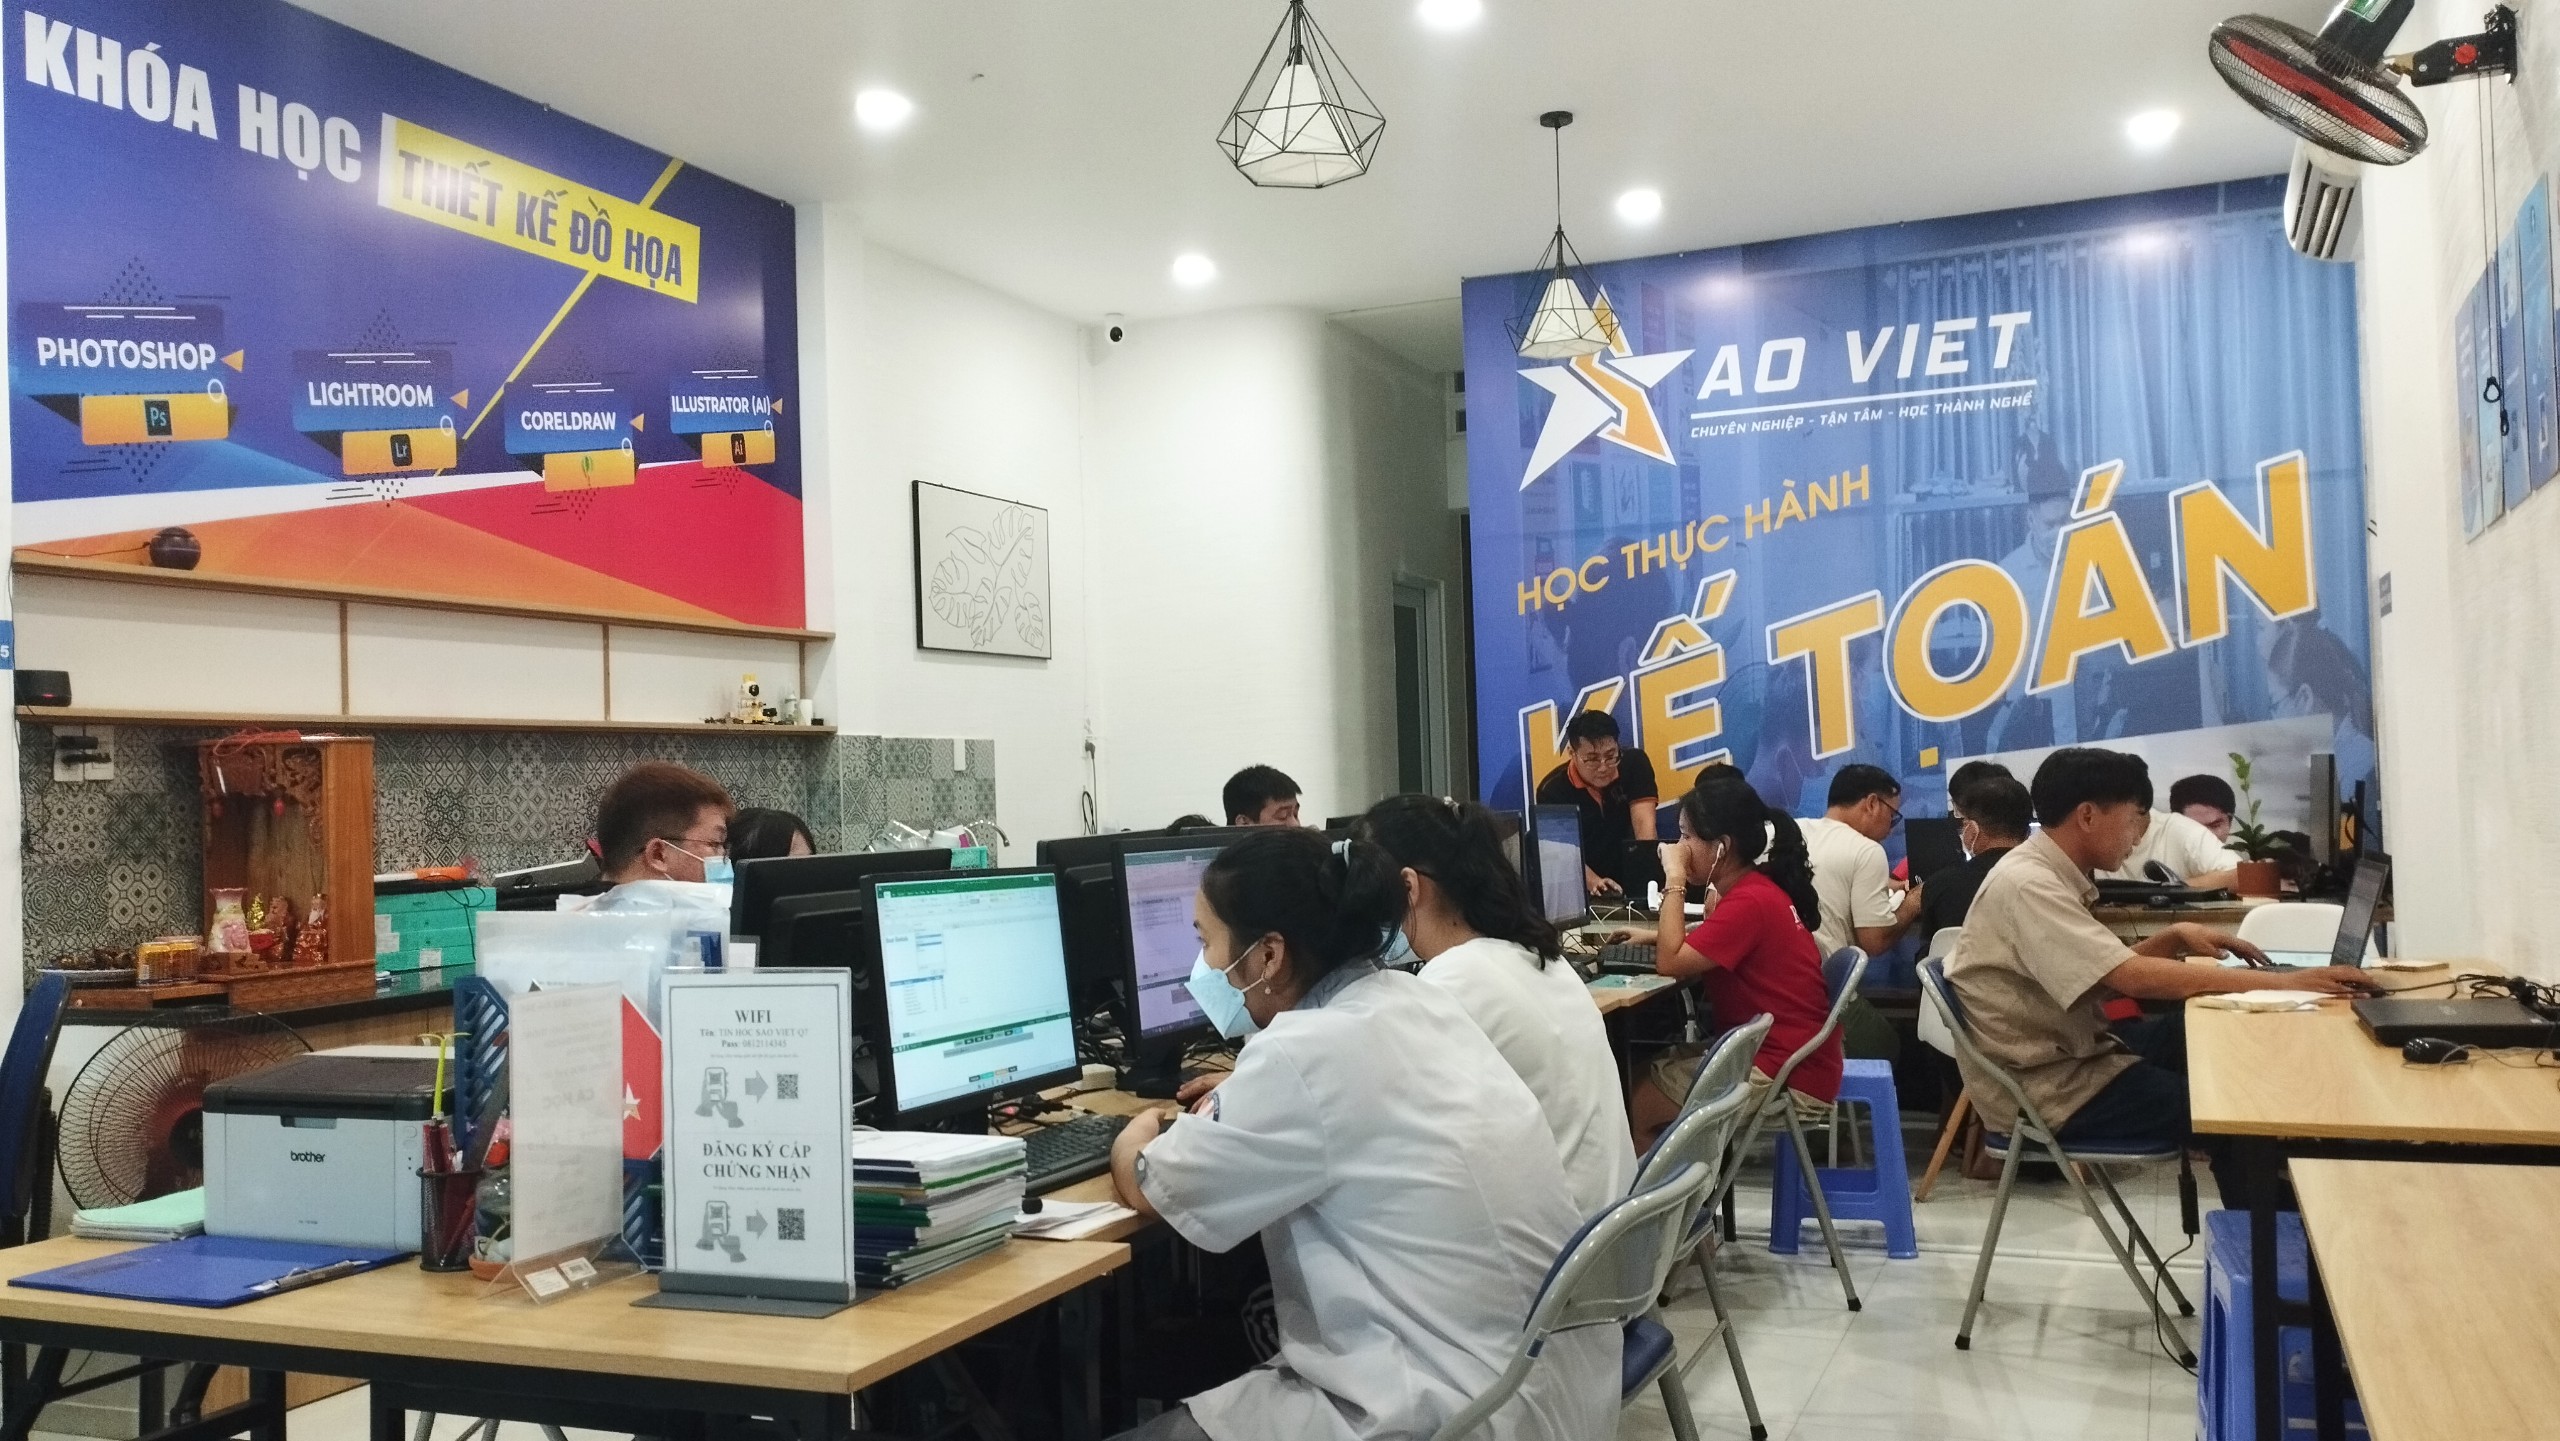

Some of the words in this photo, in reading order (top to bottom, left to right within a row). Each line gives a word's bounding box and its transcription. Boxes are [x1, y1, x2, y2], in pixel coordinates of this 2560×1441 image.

[24, 10, 219, 141] KHÓA
[238, 83, 362, 184] HỌC
[398, 149, 504, 228] THIẾT
[515, 188, 569, 248] KẾ
[568, 194, 614, 264] ĐỒ
[623, 227, 683, 290] HỌA
[36, 336, 217, 371] PHOTOSHOP
[307, 381, 435, 409] LIGHTROOM
[671, 395, 750, 415] ILLUSTRATOR
[751, 396, 772, 417] (AI)
[149, 406, 168, 428] Ps
[520, 411, 617, 432] CORELDRAW
[1690, 420, 1748, 439] CHUYÊN
[1750, 414, 1805, 433] NGHIỆP
[1820, 410, 1849, 428] TẬN
[1853, 407, 1883, 423] TÂM
[1898, 403, 1930, 420] HỌC
[1934, 398, 1985, 415] THÀNH
[395, 442, 408, 458] Lr
[734, 439, 744, 456] Ai
[1517, 555, 1610, 616] HỌC
[1621, 514, 1730, 580] THỰC
[1744, 464, 1870, 539] HÀNH
[1765, 449, 2319, 762] TOÁN
[735, 1009, 772, 1024] WIFI
[290, 1150, 326, 1163] brother
[703, 1139, 748, 1158] ĐĂNG
[752, 1139, 775, 1158] KÝ
[703, 1160, 762, 1179] CHỨNG
[766, 1162, 811, 1183] NHẬN
